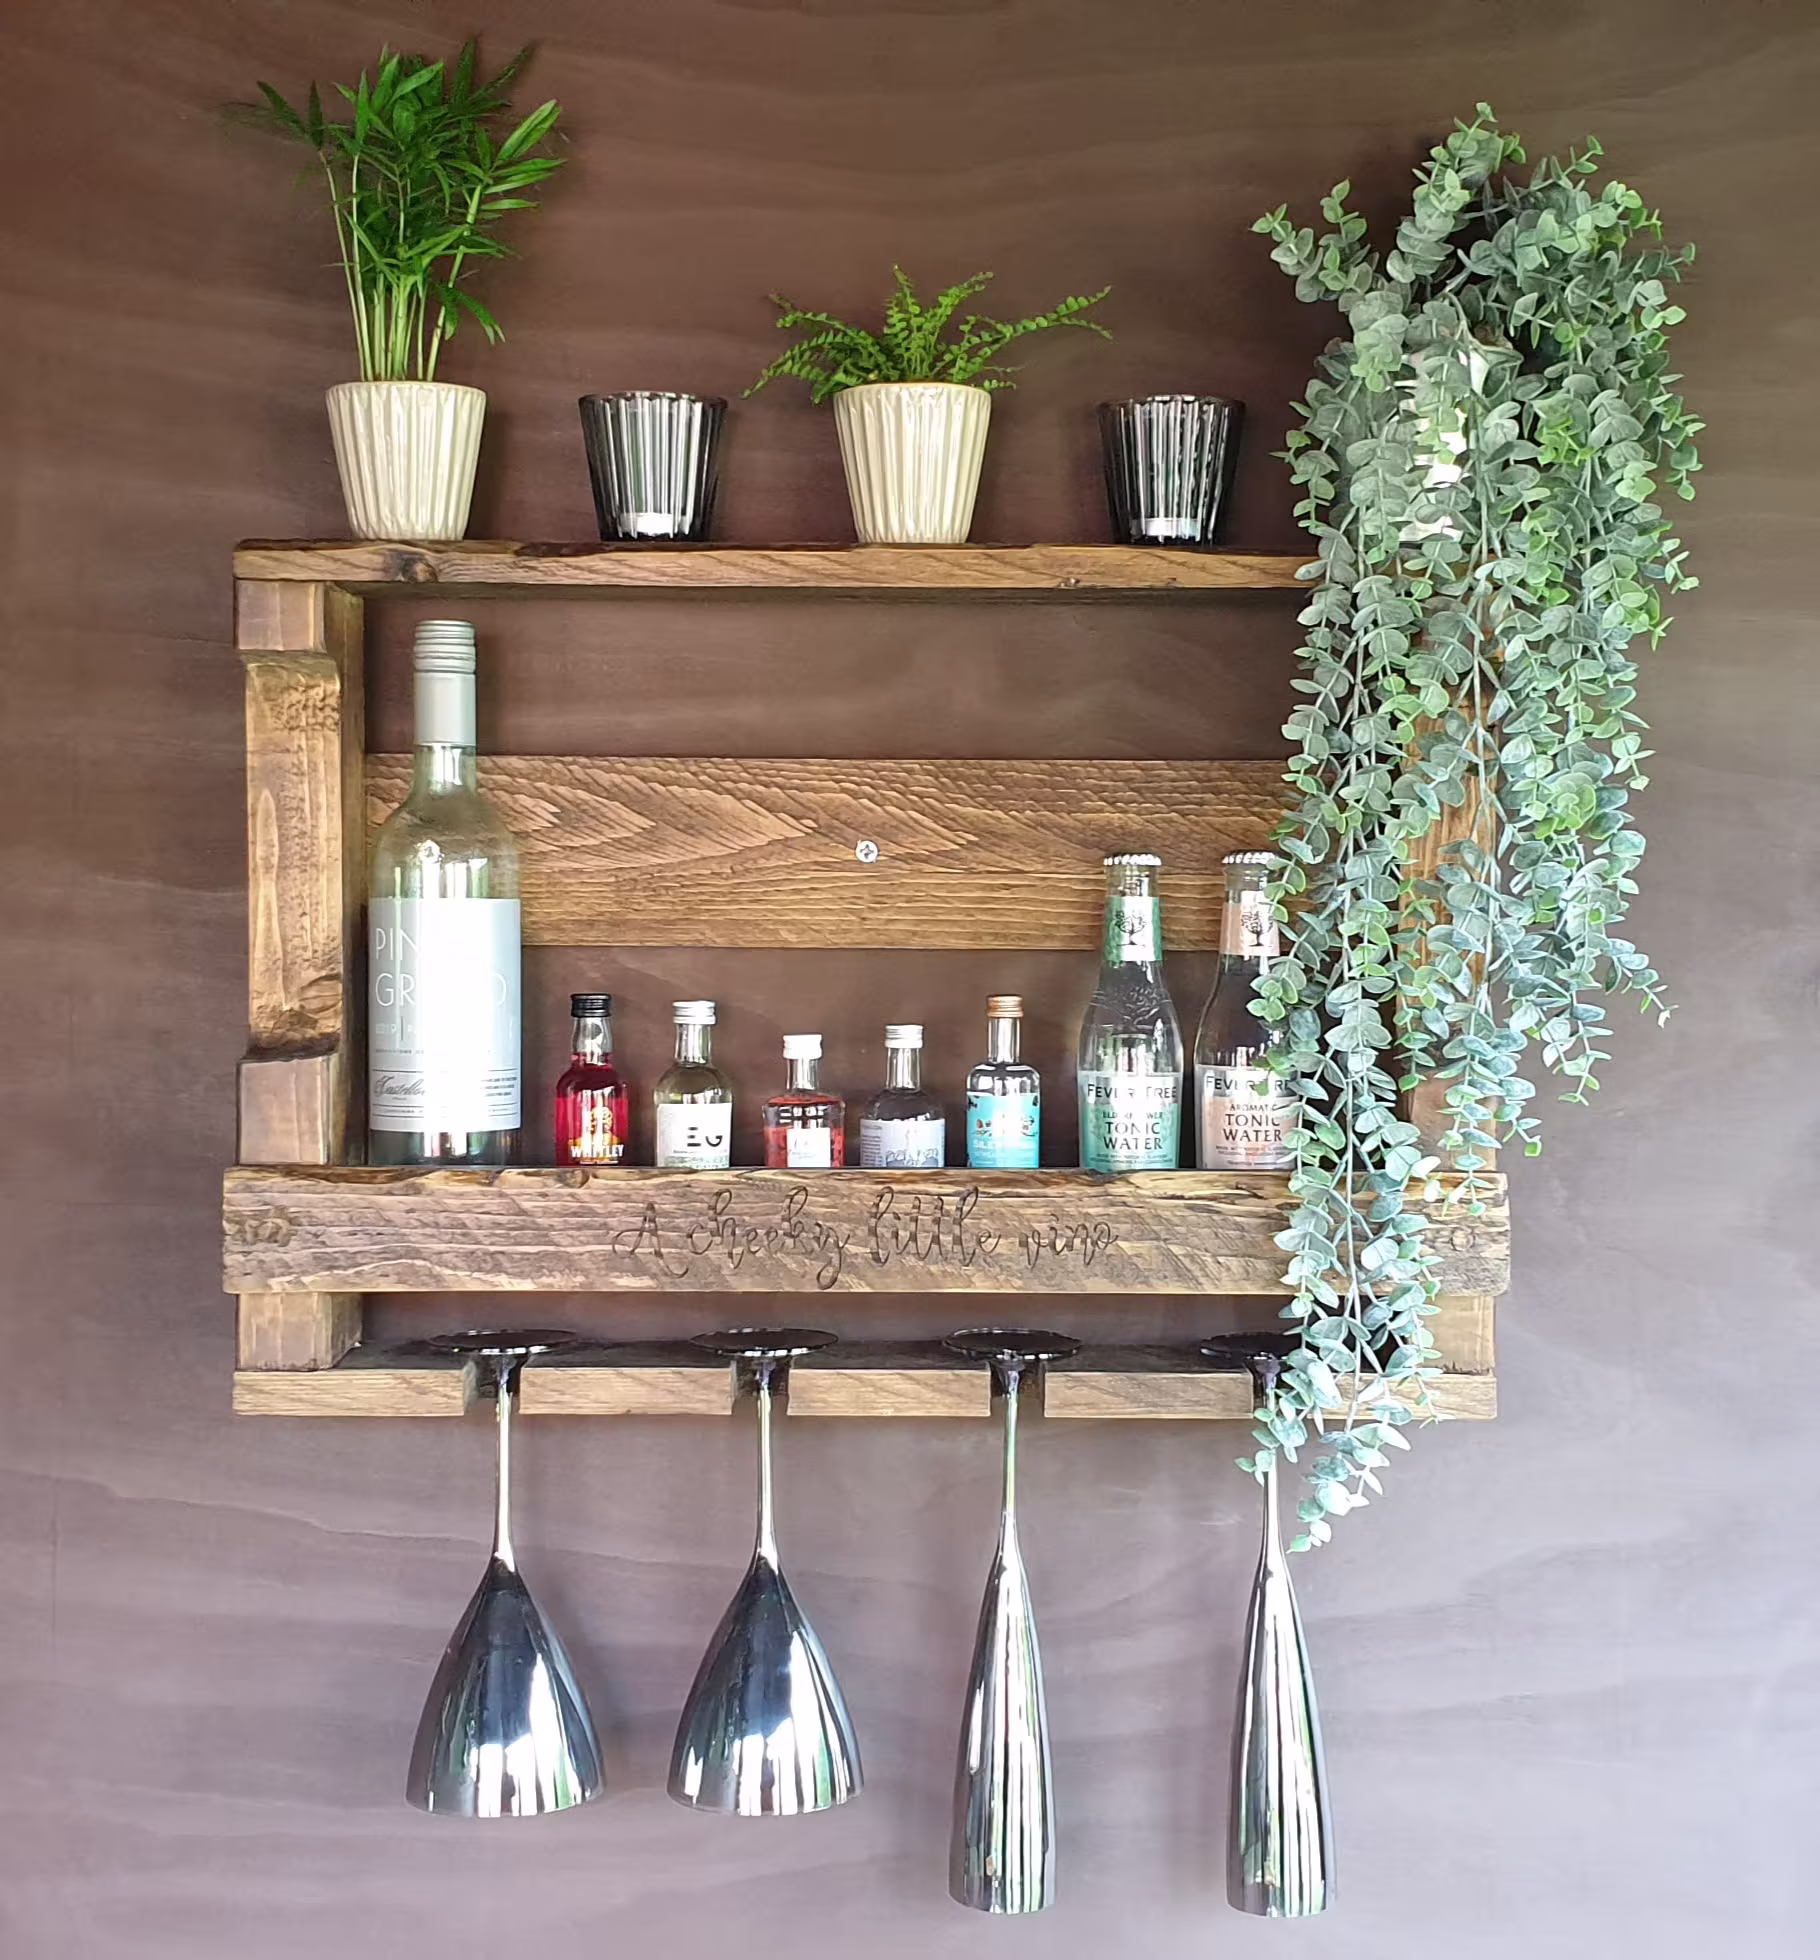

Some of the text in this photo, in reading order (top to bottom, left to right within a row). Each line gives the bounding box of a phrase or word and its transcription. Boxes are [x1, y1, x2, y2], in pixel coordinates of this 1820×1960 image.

[375, 927, 423, 961] PIN
[375, 972, 507, 1007] GRO
[1229, 1104, 1276, 1112] AROMATC
[1225, 1113, 1280, 1127] TONIC
[1105, 1121, 1161, 1135] TONIC
[1222, 1129, 1282, 1142] WATER
[1103, 1137, 1163, 1150] WATER
[612, 1186, 1119, 1291] A cheeky little vino
